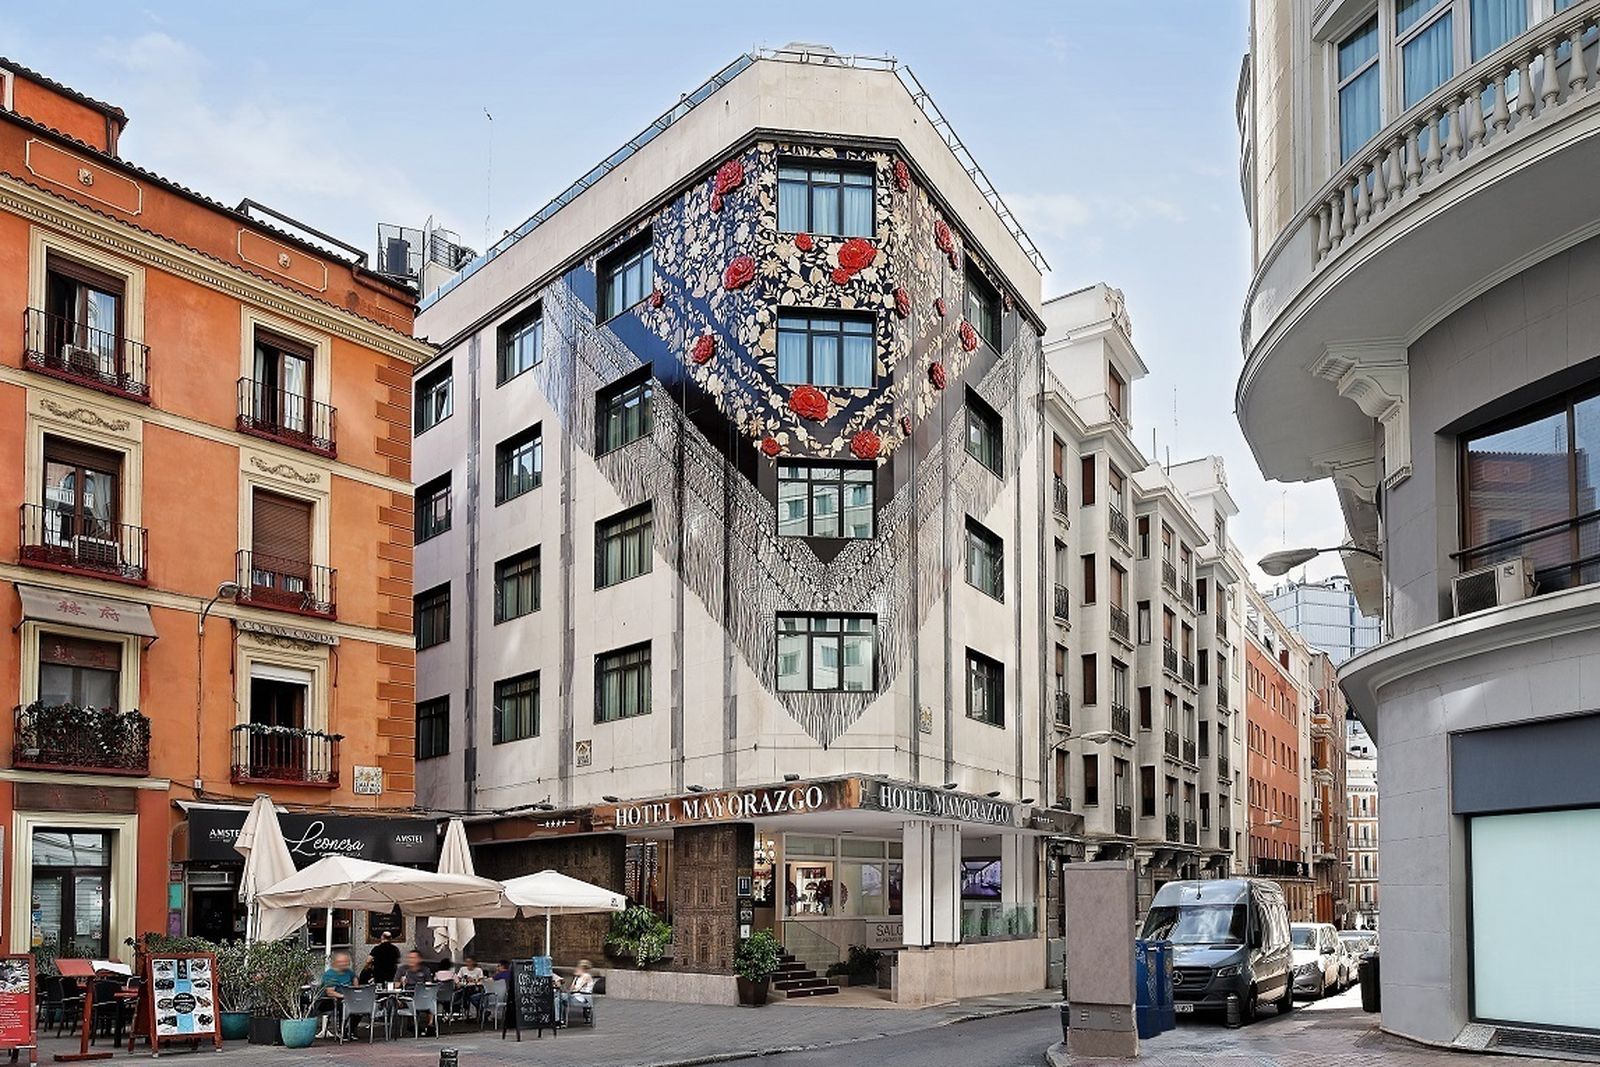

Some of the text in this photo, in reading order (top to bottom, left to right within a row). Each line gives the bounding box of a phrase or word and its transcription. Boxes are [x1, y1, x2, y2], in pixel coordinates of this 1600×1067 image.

[615, 786, 823, 827] HOTEL MAYORAZGO
[880, 786, 1010, 823] HOTEL MAYORAZGO
[209, 828, 240, 837] AMSTE
[395, 834, 424, 844] AMSTEL
[876, 924, 903, 936] SALO
